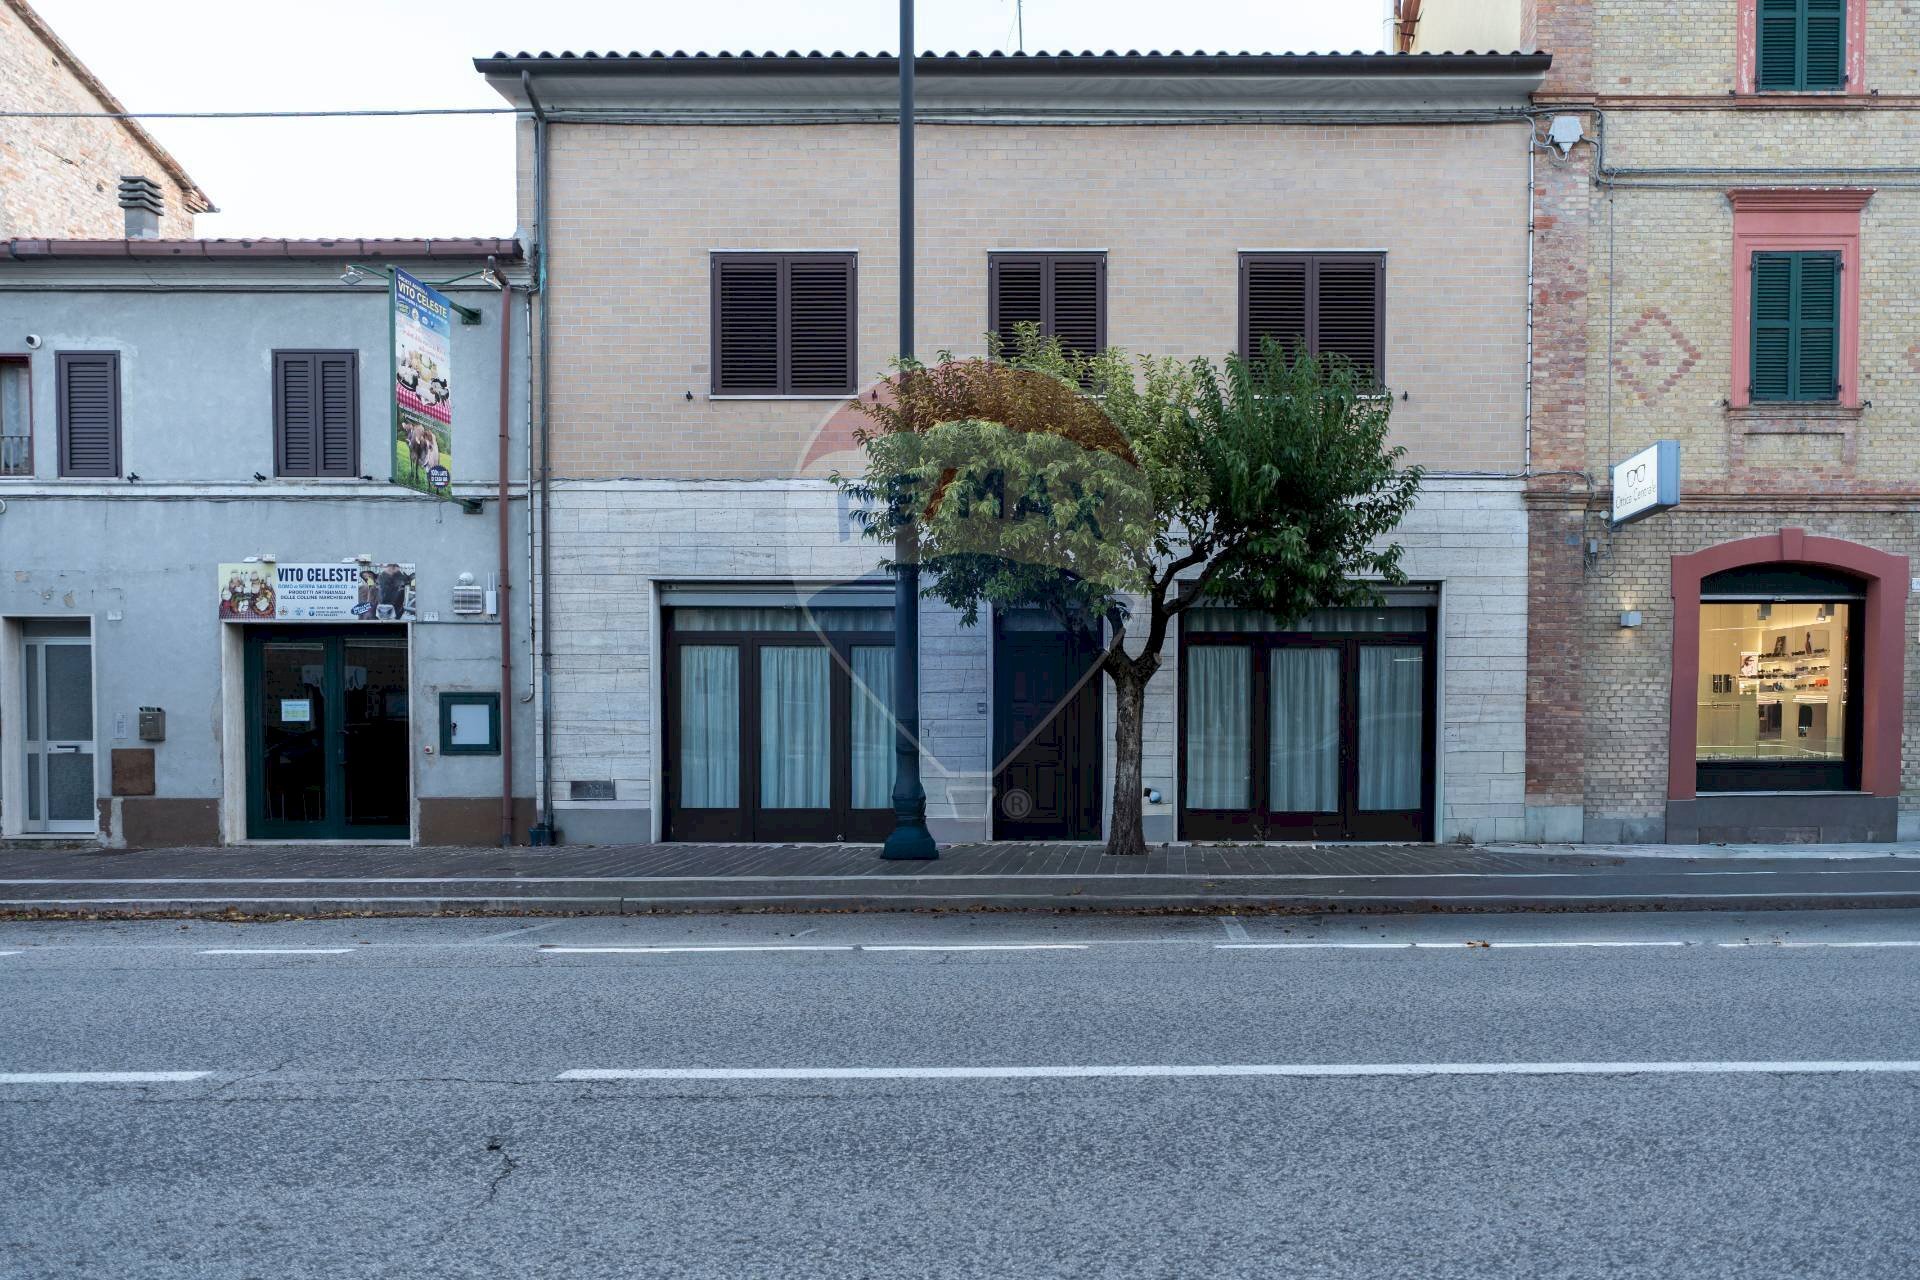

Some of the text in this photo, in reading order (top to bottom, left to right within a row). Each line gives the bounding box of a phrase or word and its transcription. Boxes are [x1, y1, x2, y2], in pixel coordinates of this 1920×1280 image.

[397, 280, 415, 299] VITO
[416, 292, 448, 319] CELESTE
[277, 567, 358, 583] VITO CELESTE
